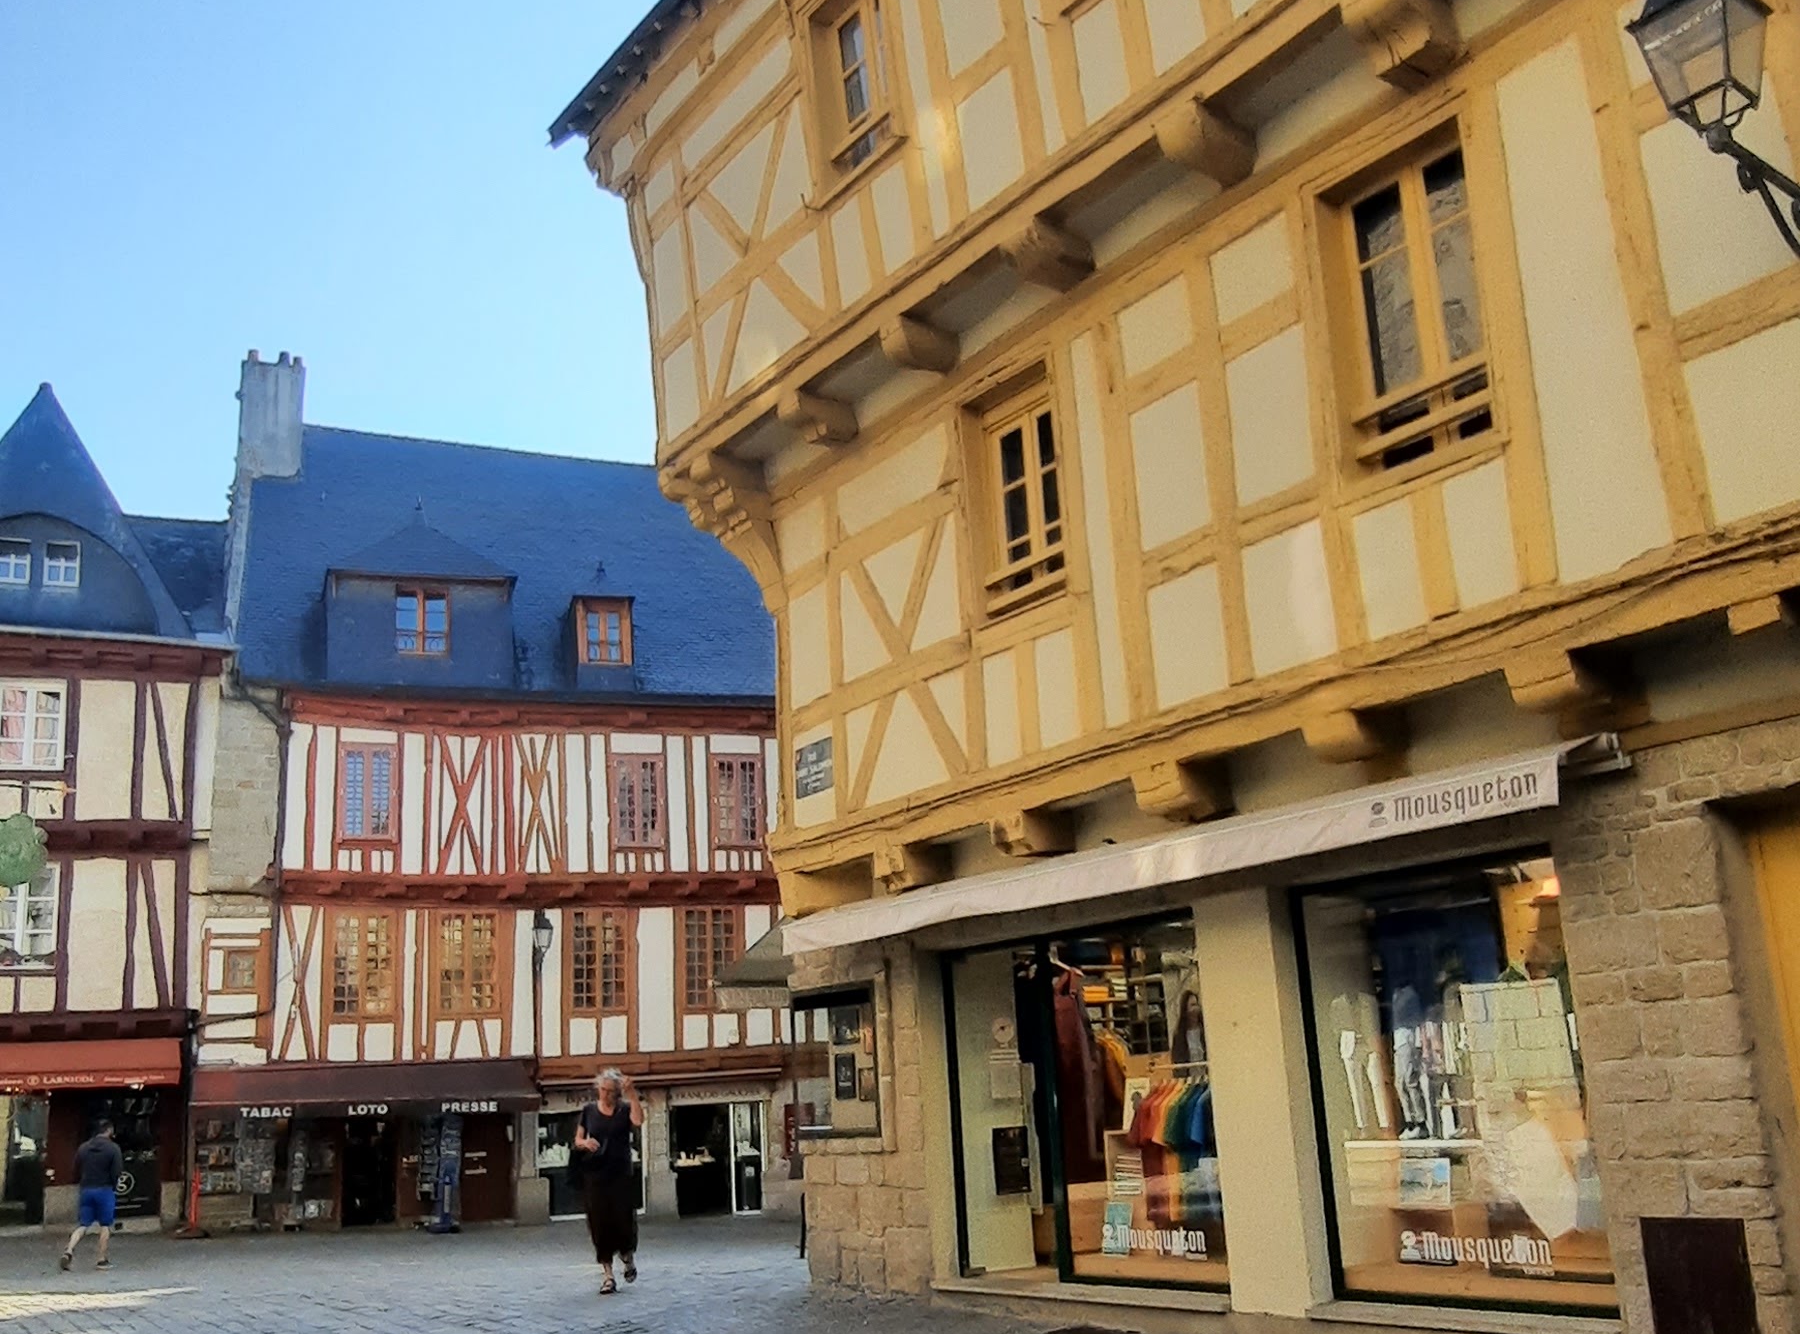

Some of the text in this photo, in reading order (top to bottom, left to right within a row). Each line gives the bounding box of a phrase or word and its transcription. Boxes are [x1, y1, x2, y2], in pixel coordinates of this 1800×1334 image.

[1394, 772, 1538, 823] Mousqueton
[240, 1107, 292, 1118] TABAC
[348, 1104, 389, 1116] LOTO
[441, 1101, 498, 1113] PRESSE
